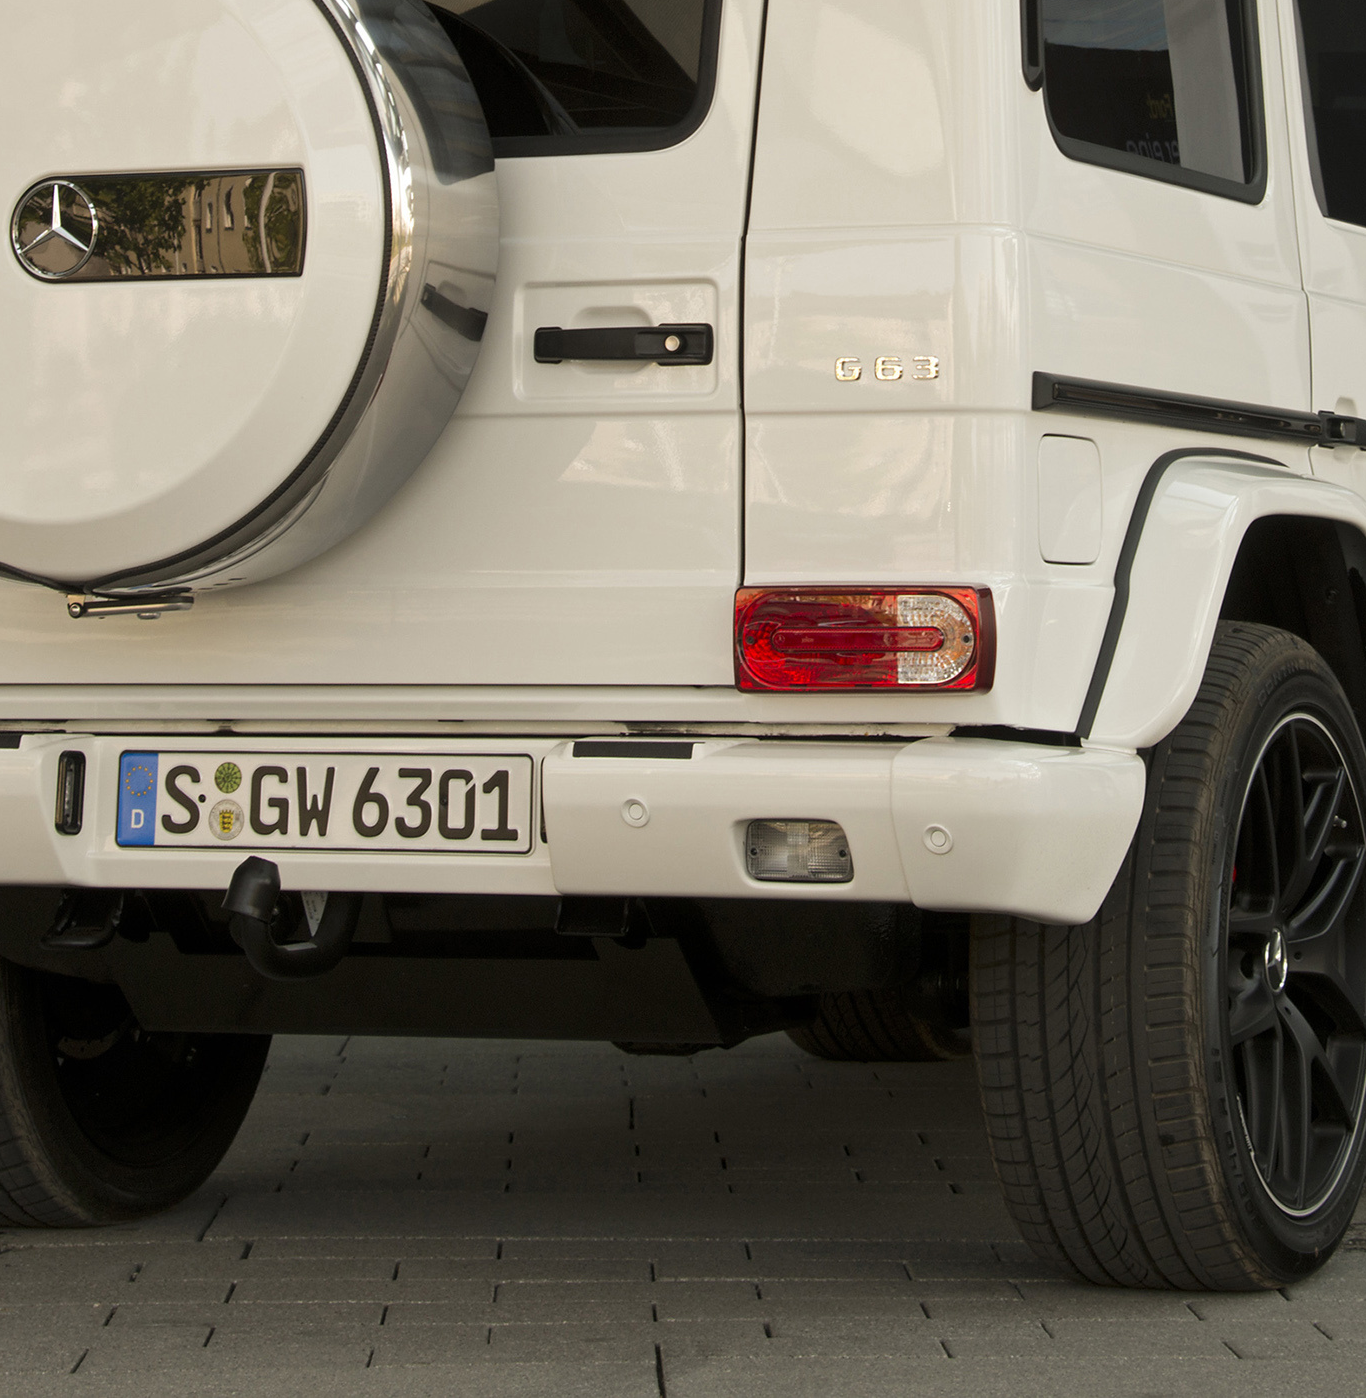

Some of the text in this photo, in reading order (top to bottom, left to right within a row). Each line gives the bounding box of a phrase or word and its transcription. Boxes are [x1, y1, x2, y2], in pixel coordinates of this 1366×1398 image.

[130, 808, 145, 830] D
[161, 765, 519, 841] S GW 6301
